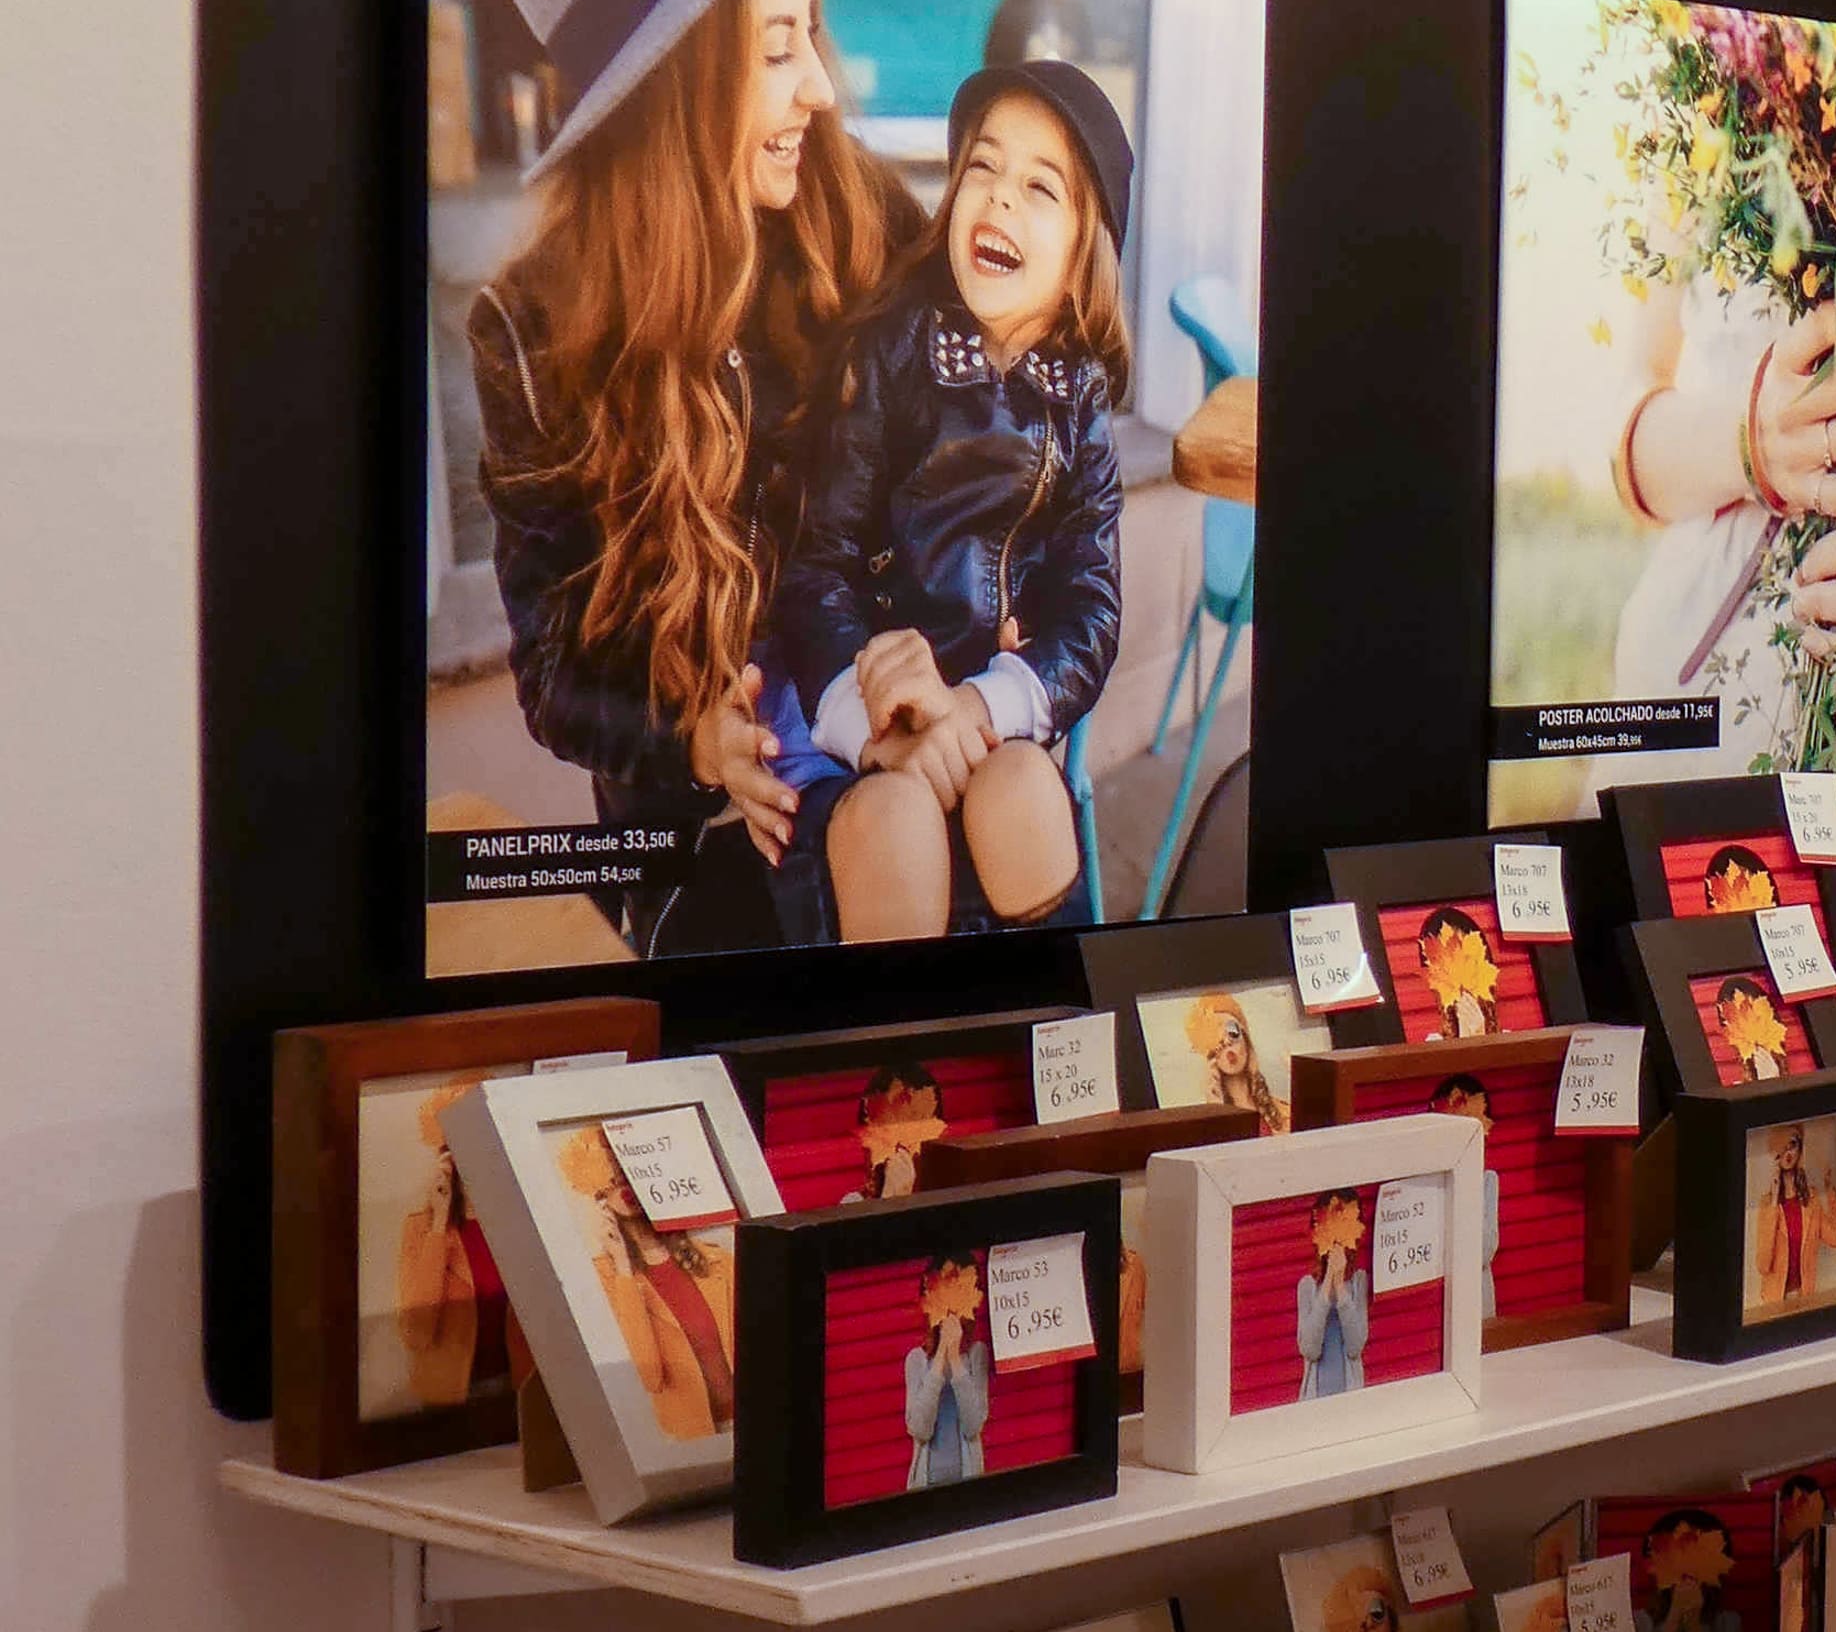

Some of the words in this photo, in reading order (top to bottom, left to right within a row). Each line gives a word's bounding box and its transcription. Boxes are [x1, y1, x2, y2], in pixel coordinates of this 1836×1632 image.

[1539, 708, 1584, 728] POSTER
[1585, 703, 1654, 724] ACOLCHADO
[1655, 706, 1682, 719] desde
[1538, 736, 1575, 751] Muestra
[466, 832, 572, 859] PANELPRIX
[575, 834, 619, 853] desde
[622, 829, 676, 851] 33,50€
[466, 871, 527, 891] Muestra
[530, 868, 597, 886] 50x50cm
[600, 866, 642, 884] 54,50€
[1500, 865, 1529, 876] Marco
[1295, 935, 1324, 946] Marco
[1039, 1044, 1065, 1060] Marc
[1068, 1040, 1081, 1054] 32
[1568, 1055, 1599, 1067] Marco
[1601, 1053, 1615, 1066] 32
[615, 1140, 655, 1158] Marco
[657, 1136, 672, 1153] 57
[1380, 1207, 1410, 1223] Marco
[1412, 1202, 1425, 1217] 52
[991, 1268, 1030, 1285] Marco
[1033, 1260, 1049, 1277] 53
